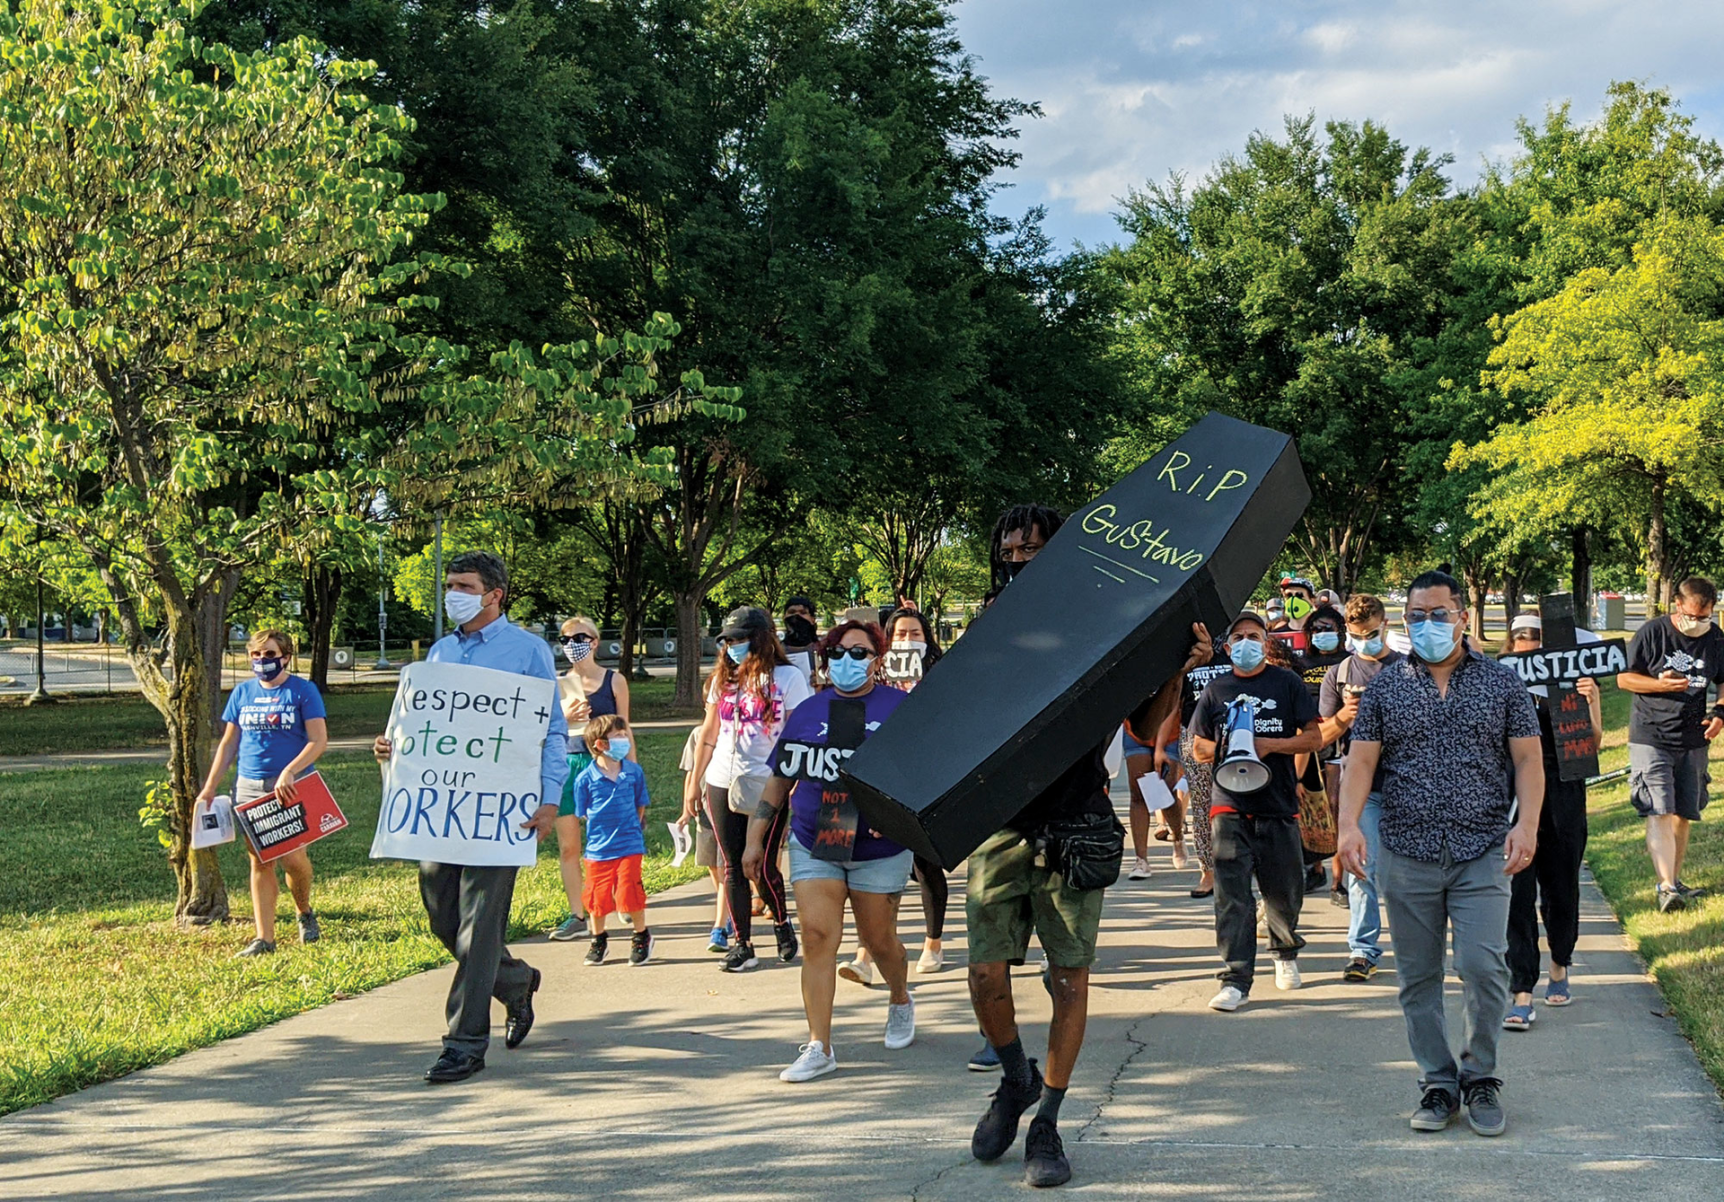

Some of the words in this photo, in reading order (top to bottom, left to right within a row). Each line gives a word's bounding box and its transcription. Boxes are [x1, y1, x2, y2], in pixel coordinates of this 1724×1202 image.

[1254, 717, 1283, 728] Dignity
[391, 720, 513, 763] rotect
[421, 769, 476, 788] our
[822, 791, 849, 804] NOT
[246, 799, 281, 823] PROTECT
[252, 804, 302, 835] IMMIGRANT
[379, 787, 538, 846] ORKERS
[832, 808, 840, 823] 1
[259, 819, 305, 847] WORKERS!
[815, 828, 857, 848] MORE
